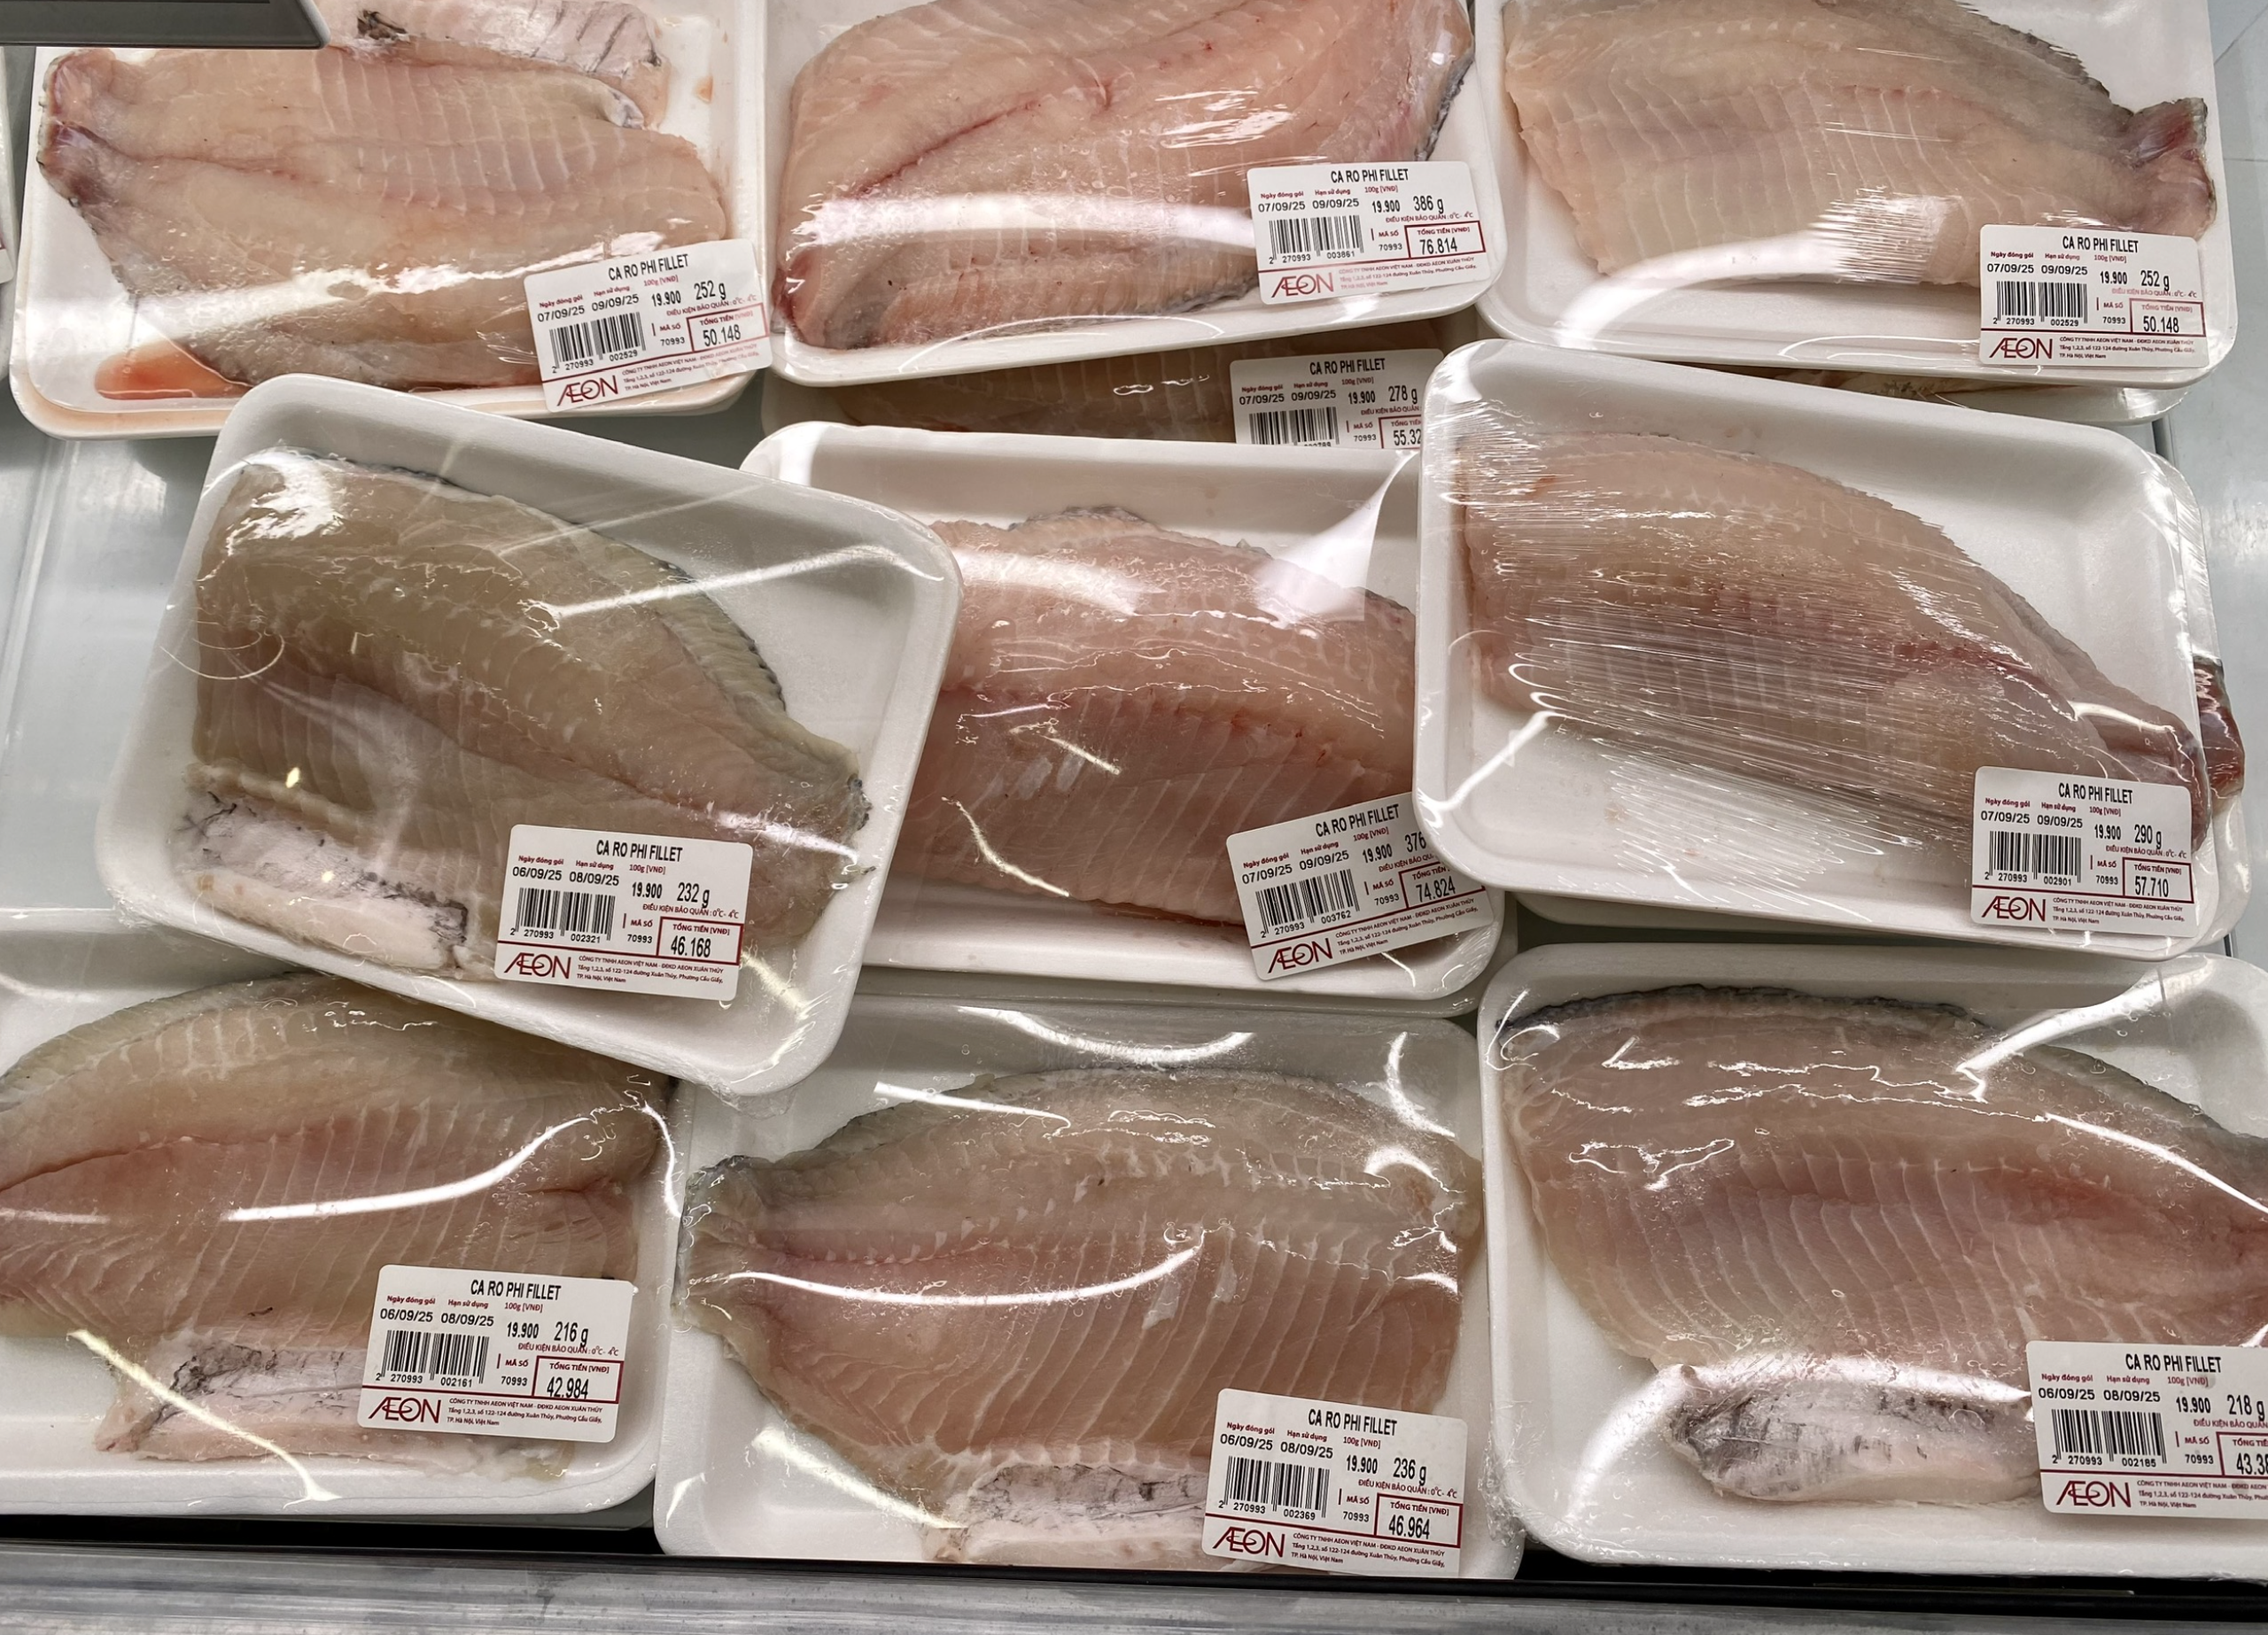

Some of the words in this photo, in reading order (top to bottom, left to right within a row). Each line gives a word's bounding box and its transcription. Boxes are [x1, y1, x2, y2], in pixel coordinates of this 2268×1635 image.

[1331, 171, 1344, 183] CA
[1347, 170, 1359, 182] RO
[1363, 169, 1378, 182] PHI
[1380, 168, 1409, 182] FILLET
[1258, 201, 1305, 213] 07/09/25
[1312, 198, 1359, 209] 09/09/25
[1372, 200, 1400, 213] 19.900
[1413, 196, 1433, 211] 386
[1437, 198, 1444, 213] g
[1419, 237, 1457, 255] 76.814
[2062, 236, 2075, 249] CA
[2078, 237, 2090, 251] RO
[2093, 238, 2108, 251] PHI
[2110, 239, 2138, 252] FILLET
[1283, 253, 1310, 263] 270993
[1327, 251, 1355, 260] 003861
[609, 266, 622, 281] CA
[625, 263, 638, 277] RO
[641, 260, 656, 275] PHI
[659, 254, 689, 273] FILLET
[1987, 263, 2034, 273] 07/09/25
[2041, 265, 2087, 275] 09/09/25
[2100, 271, 2127, 284] 19.900
[2140, 270, 2160, 287] 252
[2163, 275, 2170, 291] g
[651, 291, 681, 306] 19.900
[694, 280, 715, 300] 252
[718, 283, 726, 299] g
[592, 294, 639, 311] 09/09/25
[538, 305, 585, 322] 07/09/25
[2143, 316, 2179, 333] 50.148
[660, 337, 685, 345] 70993
[703, 325, 741, 346] 50.148
[565, 359, 594, 371] 270993
[610, 350, 638, 362] 002529
[1309, 362, 1322, 375] CA
[1324, 361, 1338, 374] RO
[1340, 360, 1355, 373] PHI
[1357, 358, 1386, 372] FILLET
[1239, 394, 1285, 405] 07/09/25
[1291, 390, 1336, 401] 09/09/25
[1348, 391, 1376, 404] 19.900
[1388, 385, 1408, 402] 278
[1411, 389, 1418, 404] g
[1394, 429, 1421, 446] 55.32
[2059, 783, 2071, 798] CA
[2073, 785, 2085, 799] RO
[2089, 787, 2103, 801] PHI
[2105, 787, 2132, 803] FILLET
[1316, 823, 1331, 837] CA
[1332, 818, 1347, 833] RO
[1348, 812, 1366, 829] PHI
[1369, 803, 1400, 825] FILLET
[1981, 810, 2030, 824] 07/09/25
[2037, 816, 2083, 828] 09/09/25
[2094, 824, 2121, 841] 19.900
[2134, 825, 2153, 844] 290
[2155, 831, 2162, 849] g
[1404, 831, 1426, 853] 376
[596, 840, 610, 856] CA
[613, 841, 627, 857] RO
[630, 843, 647, 859] PHI
[649, 845, 682, 862] FILLET
[1363, 844, 1393, 864] 19.900
[1300, 849, 1349, 871] 09/09/25
[512, 866, 562, 880] 06/09/25
[570, 871, 619, 886] 08/09/25
[1242, 864, 1293, 885] 07/09/25
[1998, 872, 2027, 882] 270993
[2044, 876, 2071, 886] 002901
[2096, 876, 2118, 885] 70993
[632, 882, 662, 899] 19.900
[677, 882, 699, 903] 232
[702, 888, 710, 908] g
[1416, 876, 1456, 903] 74.824
[2135, 876, 2169, 897] 57.710
[1374, 894, 1400, 906] 70993
[1274, 922, 1305, 935] 270993
[1321, 910, 1351, 925] 003762
[524, 930, 554, 939] 270993
[571, 934, 601, 943] 002321
[627, 934, 652, 943] 70993
[671, 936, 711, 957] 46.168
[471, 1280, 485, 1296] CA
[488, 1281, 503, 1297] RO
[506, 1282, 524, 1298] PHI
[526, 1283, 561, 1300] FILLET
[380, 1308, 433, 1322] 06/09/25
[505, 1302, 521, 1312] 100g
[441, 1313, 494, 1327] 08/09/25
[507, 1321, 539, 1338] 19.900
[554, 1321, 578, 1341] 216
[580, 1328, 588, 1347] g
[2126, 1354, 2141, 1370] CA
[2144, 1355, 2160, 1371] RO
[2163, 1355, 2183, 1371] PHI
[2186, 1356, 2221, 1373] FILLET
[391, 1374, 423, 1383] 270993
[440, 1377, 472, 1387] 002161
[501, 1376, 527, 1386] 70993
[547, 1376, 588, 1399] 42.984
[2039, 1388, 2095, 1400] 06/09/25
[2104, 1390, 2160, 1402] 08/09/25
[2176, 1397, 2210, 1413] 19.900
[2227, 1395, 2252, 1415] 218
[2256, 1400, 2264, 1421] g
[1309, 1408, 1322, 1426] CA
[1325, 1412, 1340, 1429] RO
[1343, 1414, 1361, 1431] PHI
[1363, 1417, 1397, 1436] FILLET
[1220, 1434, 1273, 1451] 06/09/25
[1280, 1441, 1333, 1459] 08/09/25
[1346, 1454, 1378, 1475] 19.900
[2068, 1455, 2102, 1466] 270993
[2122, 1458, 2156, 1468] 002185
[2185, 1454, 2214, 1464] 70993
[1394, 1457, 1416, 1479] 236
[1418, 1465, 1426, 1485] g
[1233, 1502, 1265, 1514] 270993
[1284, 1509, 1316, 1521] 002369
[1343, 1511, 1370, 1523] 70993
[1389, 1515, 1430, 1539] 46.964
